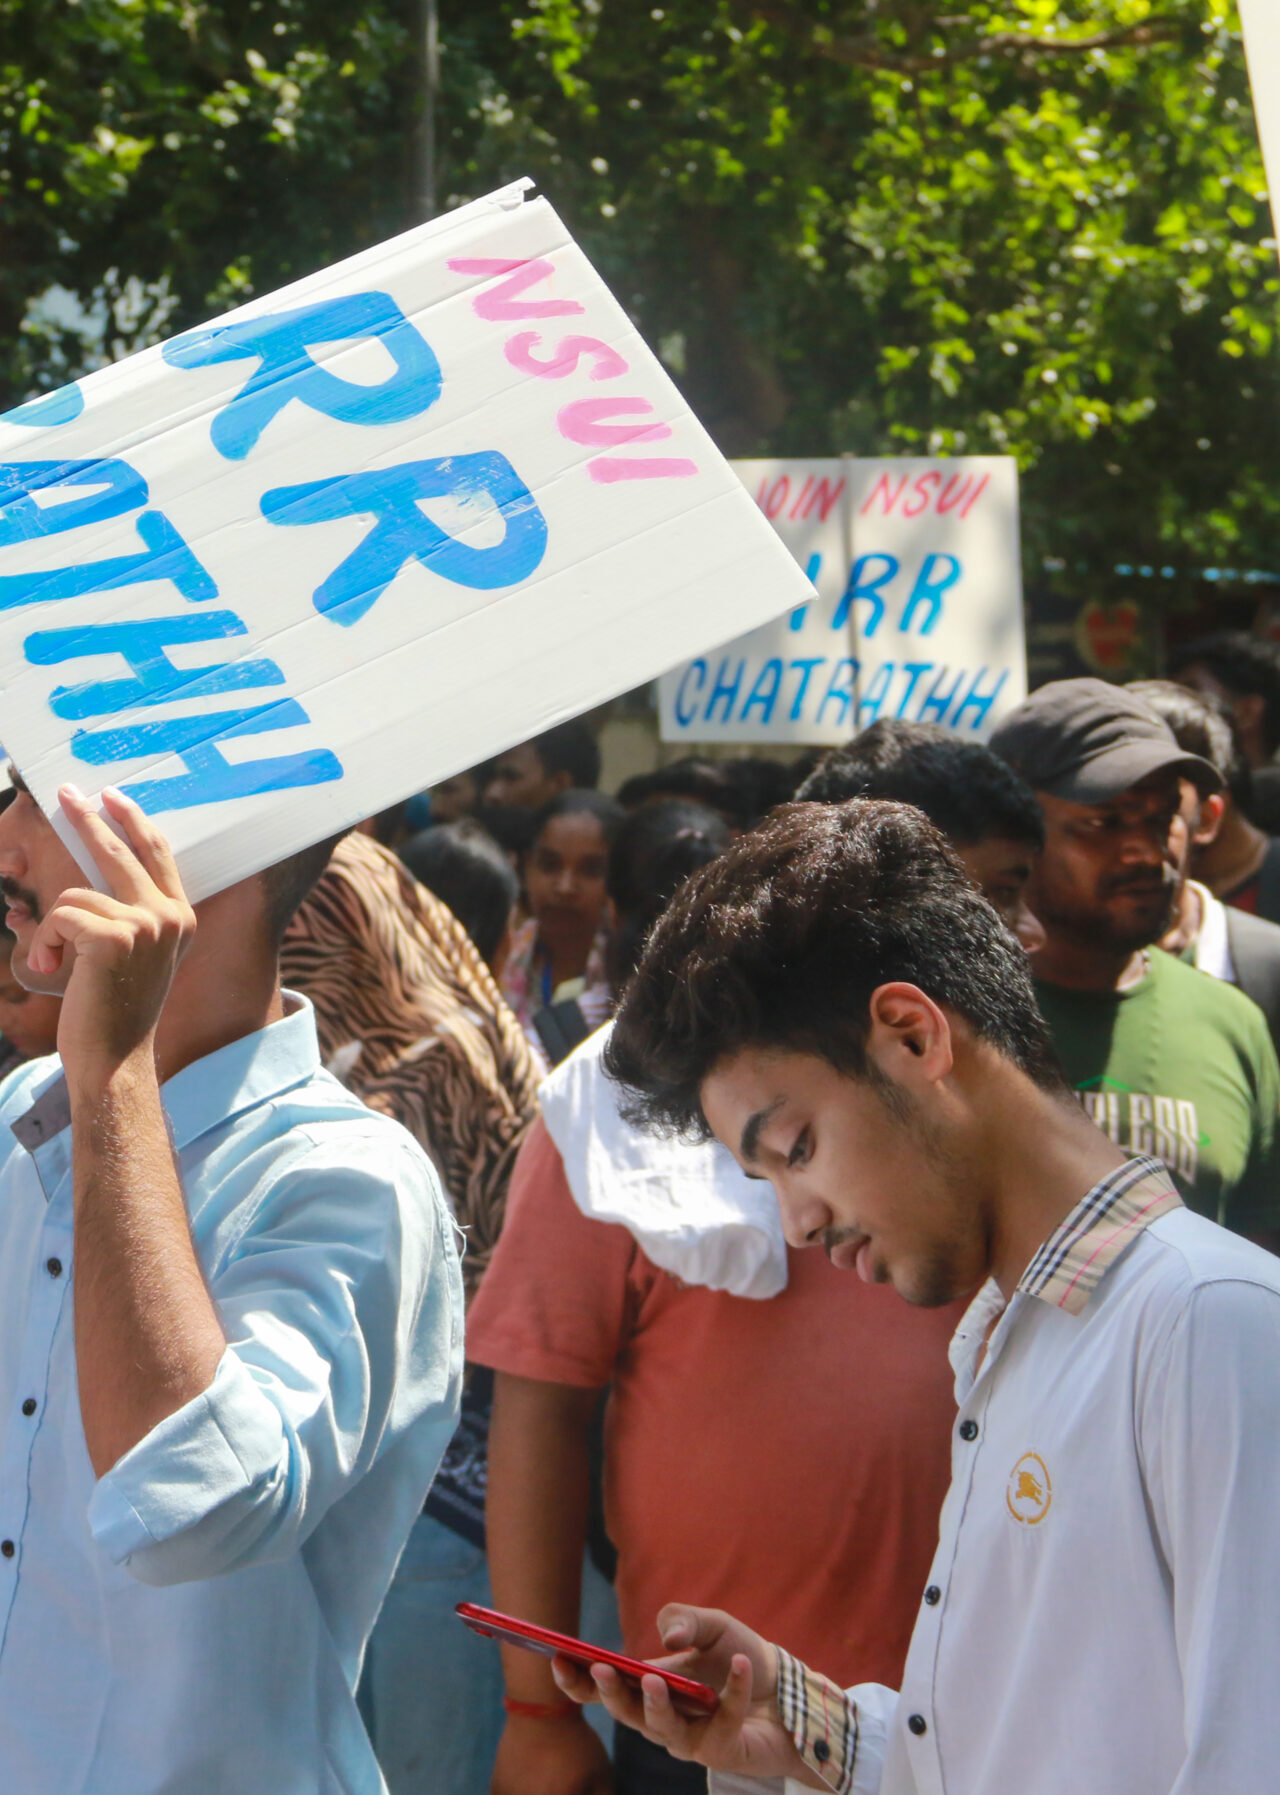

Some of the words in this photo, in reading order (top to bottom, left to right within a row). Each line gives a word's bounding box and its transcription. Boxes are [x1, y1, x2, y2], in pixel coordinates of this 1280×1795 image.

[446, 256, 698, 484] NSUI
[161, 290, 548, 627] RR
[859, 470, 990, 520] NSUI
[674, 656, 1009, 731] CHATRATHH
